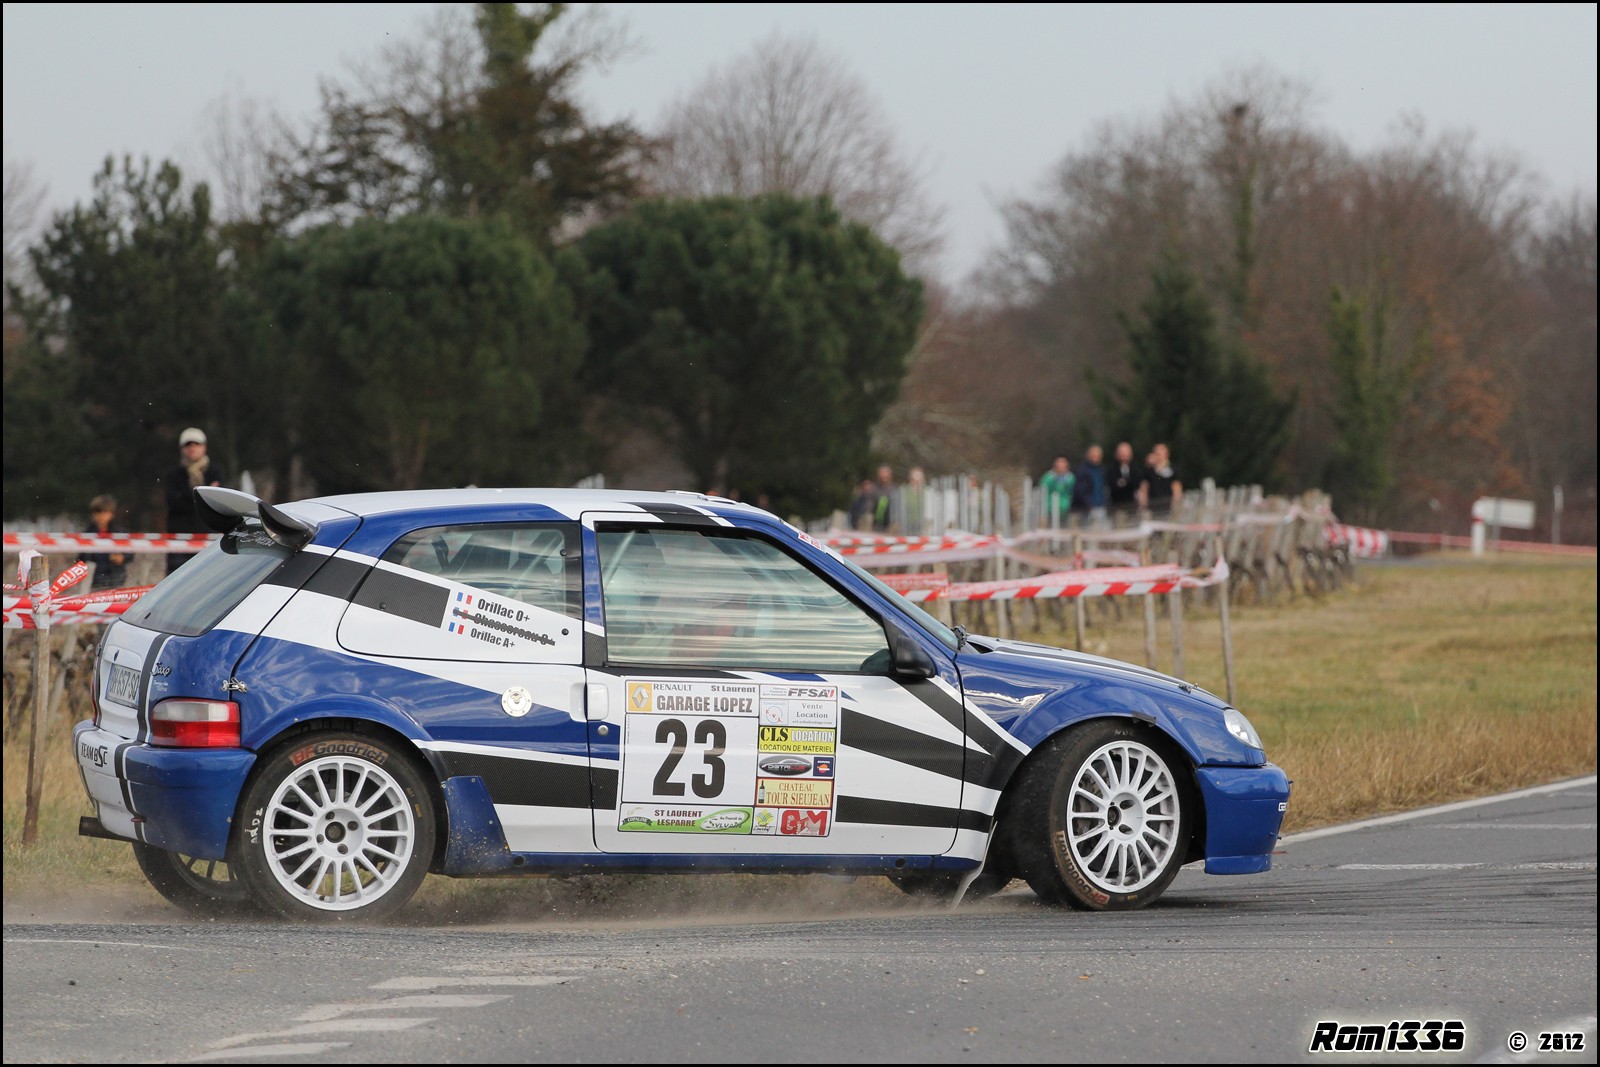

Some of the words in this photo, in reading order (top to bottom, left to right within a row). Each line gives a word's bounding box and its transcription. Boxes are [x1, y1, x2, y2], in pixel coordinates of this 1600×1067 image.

[477, 598, 514, 618] Orillac
[470, 627, 502, 645] Orillac
[502, 637, 516, 648] A+
[653, 683, 693, 692] RENAULT
[711, 684, 720, 693] St
[721, 685, 756, 694] Laurent
[788, 687, 830, 698] FFSA
[656, 695, 710, 712] GARAGE
[713, 697, 753, 713] LOPEZ
[801, 702, 824, 710] Vente
[796, 711, 829, 719] Location
[760, 727, 789, 742] CLS
[791, 730, 834, 743] LOCATION
[760, 743, 792, 752] LOCATION
[792, 744, 801, 752] DE
[802, 745, 833, 753] MATERIEL
[652, 718, 727, 799] 23
[778, 782, 815, 792] CHATEAU
[766, 791, 789, 804] TOUR
[790, 792, 831, 806] SIEUJEAN
[654, 809, 667, 817] ST
[666, 810, 703, 818] LAURENT
[656, 818, 696, 827] LESPARRE
